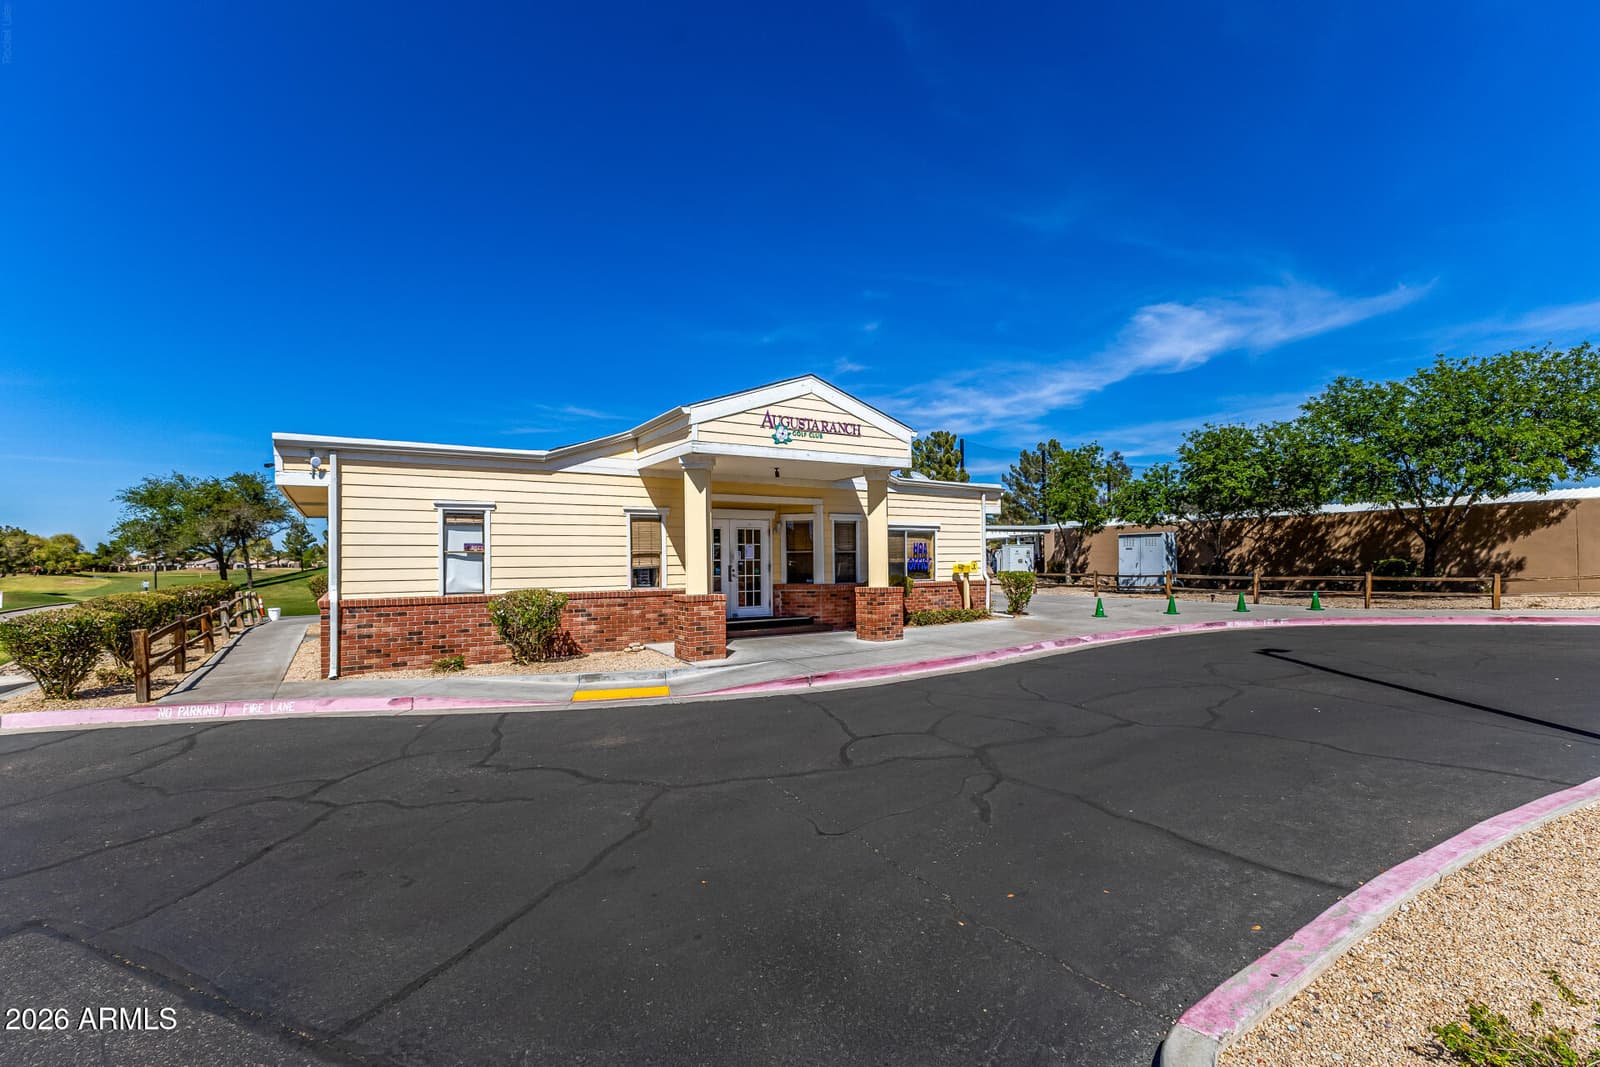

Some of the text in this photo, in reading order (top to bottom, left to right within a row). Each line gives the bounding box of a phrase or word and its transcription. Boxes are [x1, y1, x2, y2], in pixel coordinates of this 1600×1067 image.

[821, 420, 861, 436] RANCH
[792, 429, 823, 440] GOLF CLUB
[913, 542, 928, 554] HOA
[158, 705, 219, 718] NO PARKING
[242, 702, 296, 714] FIRE LANE
